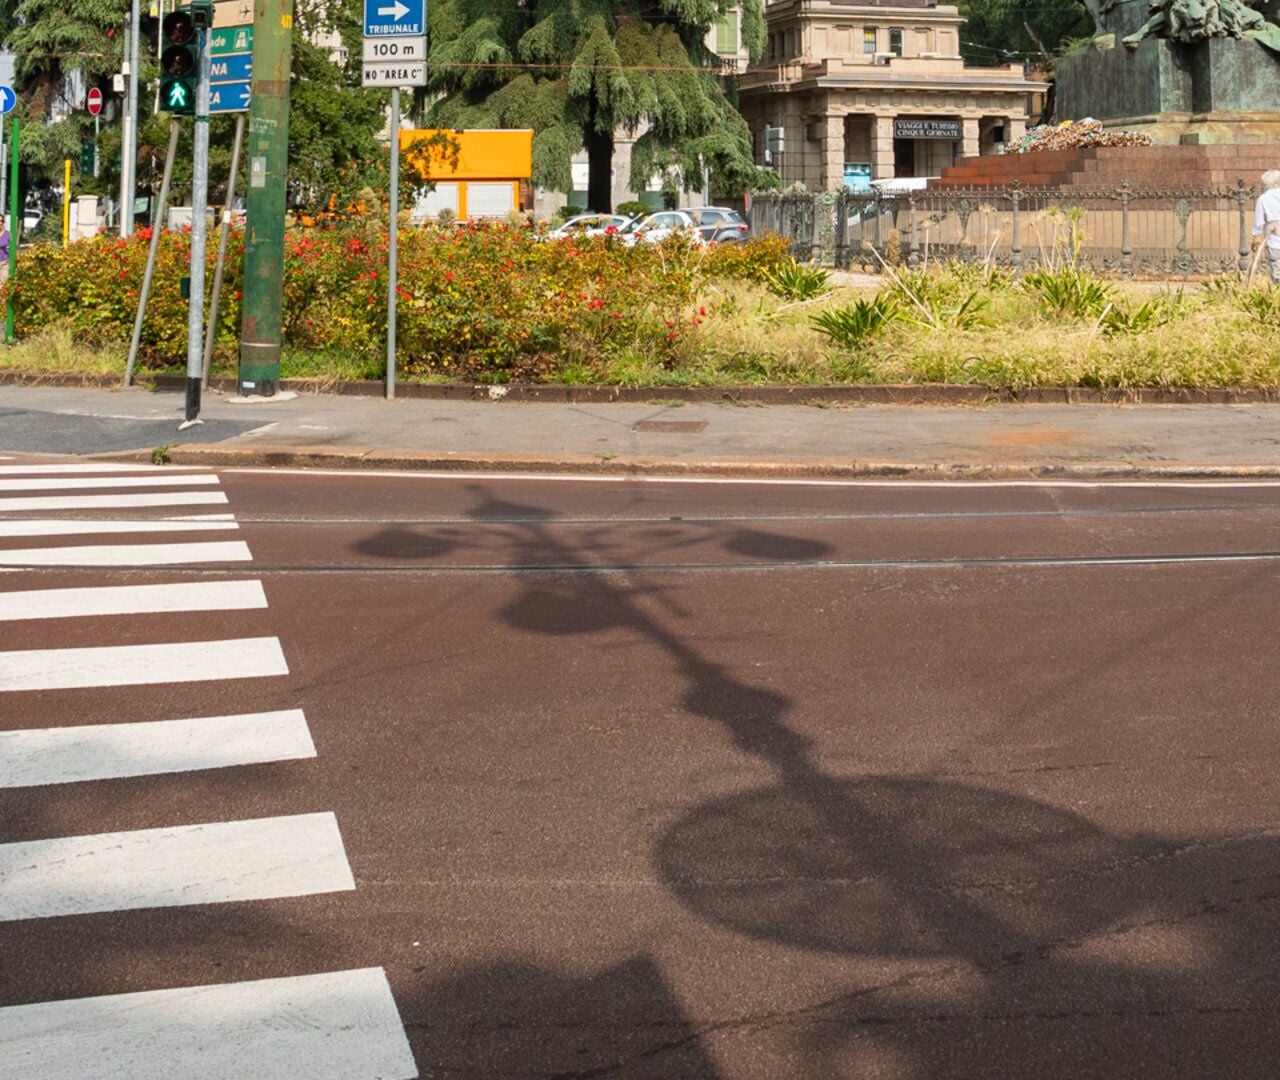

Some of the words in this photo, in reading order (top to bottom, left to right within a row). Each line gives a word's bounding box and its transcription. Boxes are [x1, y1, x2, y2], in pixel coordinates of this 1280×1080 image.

[368, 23, 419, 34] TRIBUNALE
[373, 44, 399, 56] 100
[403, 45, 415, 55] m
[365, 70, 377, 80] NO
[381, 69, 408, 80] "AREA
[411, 69, 422, 79] C"
